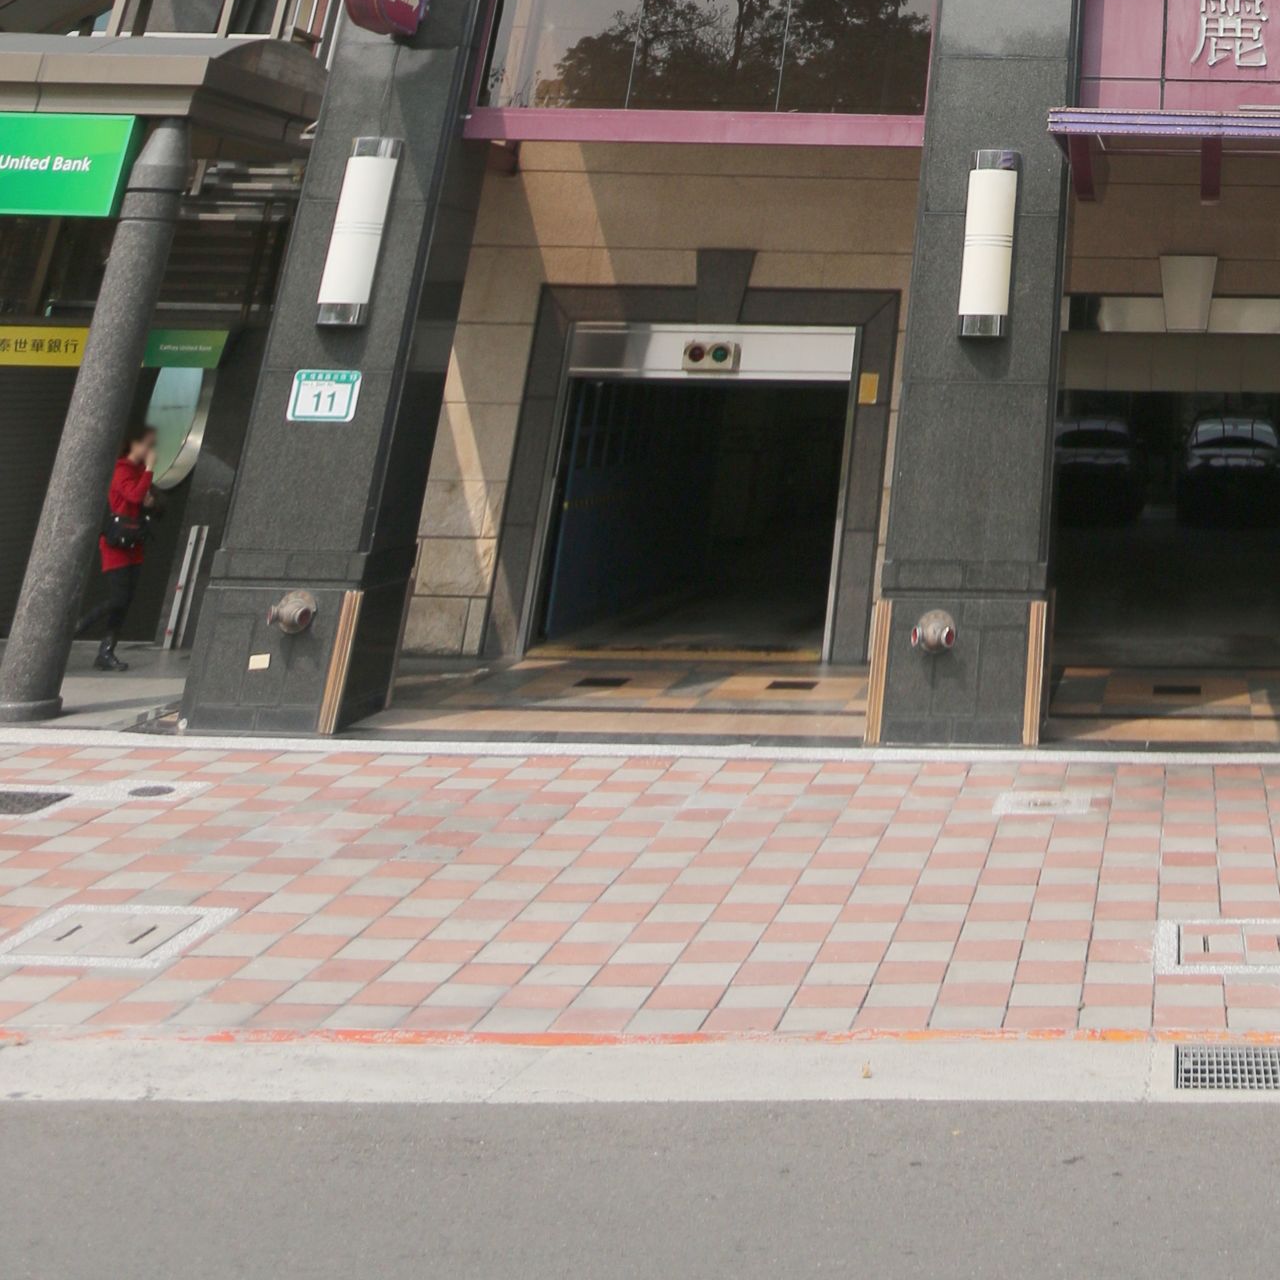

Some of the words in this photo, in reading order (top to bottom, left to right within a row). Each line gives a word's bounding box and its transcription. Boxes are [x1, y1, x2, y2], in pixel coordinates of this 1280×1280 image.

[0, 154, 51, 171] United
[52, 155, 92, 172] Bank
[312, 391, 336, 413] 11
